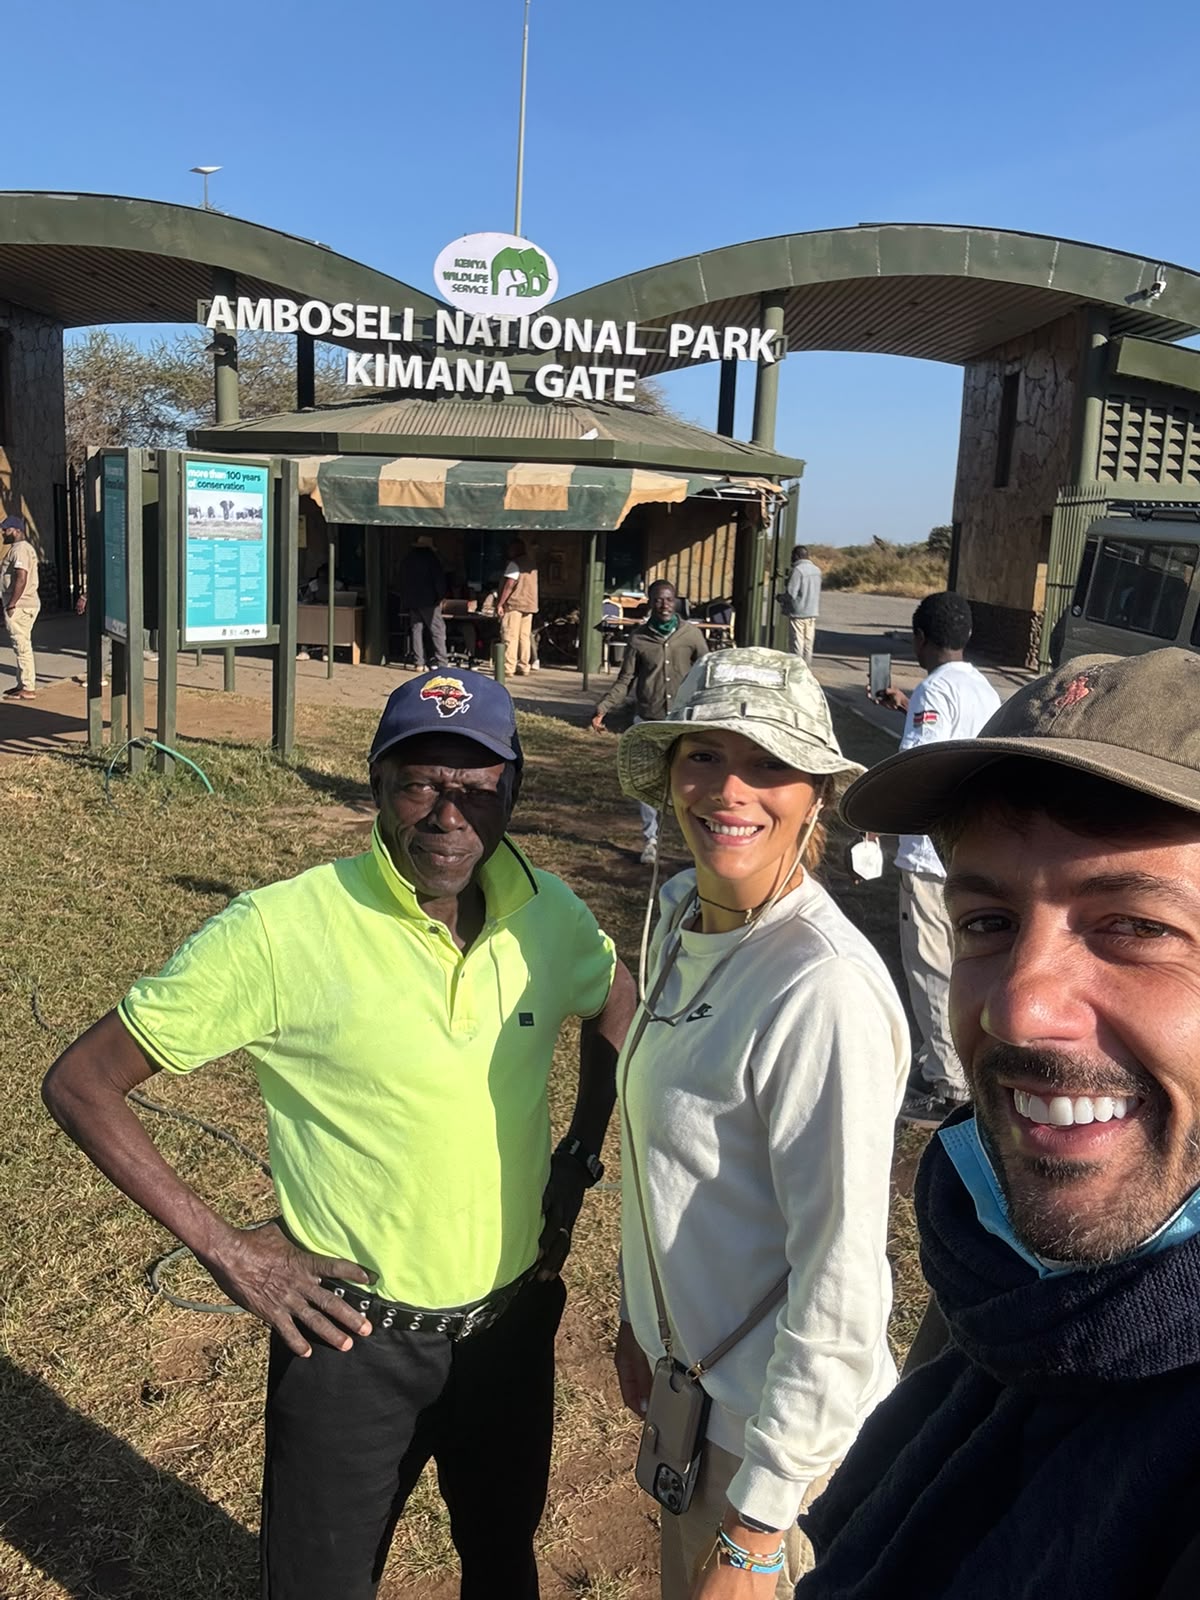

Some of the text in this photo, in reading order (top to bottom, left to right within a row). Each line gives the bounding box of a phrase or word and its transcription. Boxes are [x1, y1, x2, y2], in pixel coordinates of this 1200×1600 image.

[454, 258, 487, 270] KENYA
[442, 271, 489, 283] WILDLIFE
[452, 283, 488, 295] SERVICE
[206, 295, 777, 362] AMBOSELI NATIONAL PARK
[347, 353, 636, 402] KIMANA GATE
[226, 471, 241, 480] 100
[242, 474, 261, 482] years
[197, 481, 245, 491] conservation
